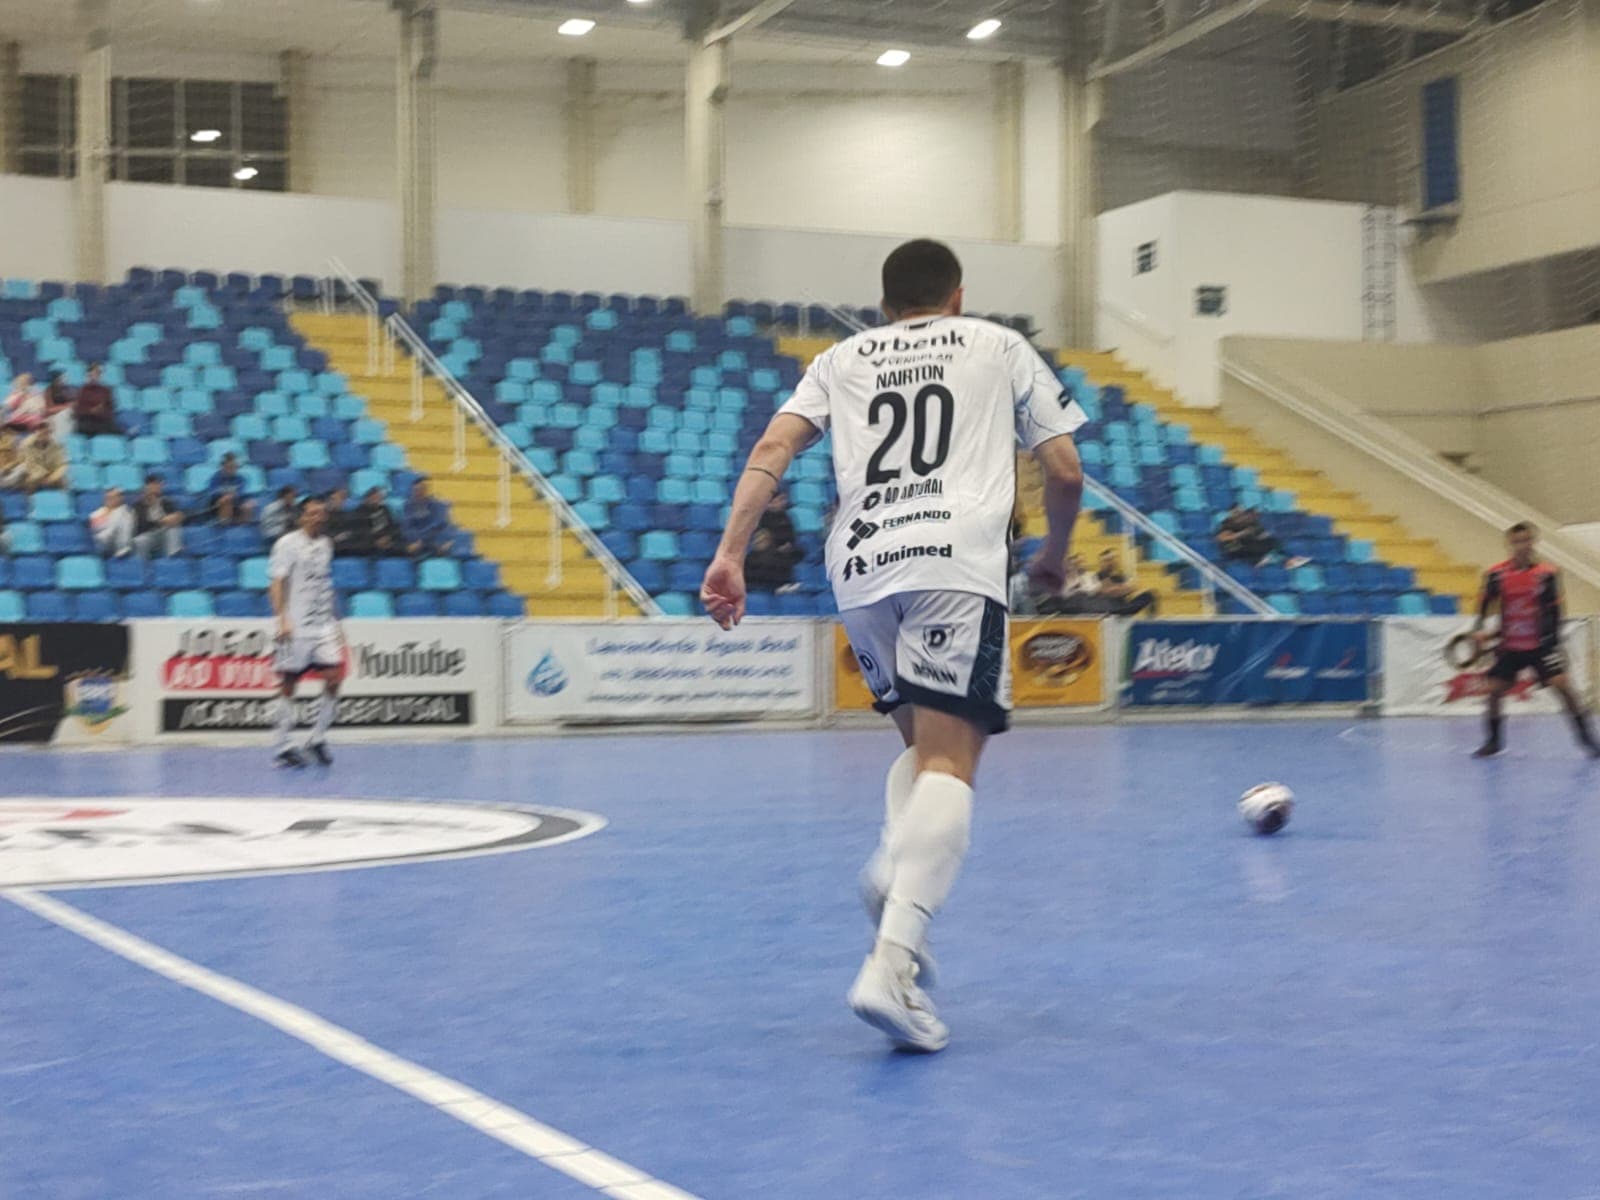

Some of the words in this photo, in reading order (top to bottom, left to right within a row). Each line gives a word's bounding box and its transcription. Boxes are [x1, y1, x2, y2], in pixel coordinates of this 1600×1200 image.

[857, 329, 966, 357] Orbenk
[875, 365, 944, 390] NAIRTON
[866, 383, 954, 486] 20
[882, 510, 952, 529] FERNANDO
[876, 543, 953, 567] Unimed
[356, 639, 467, 680] YouTube
